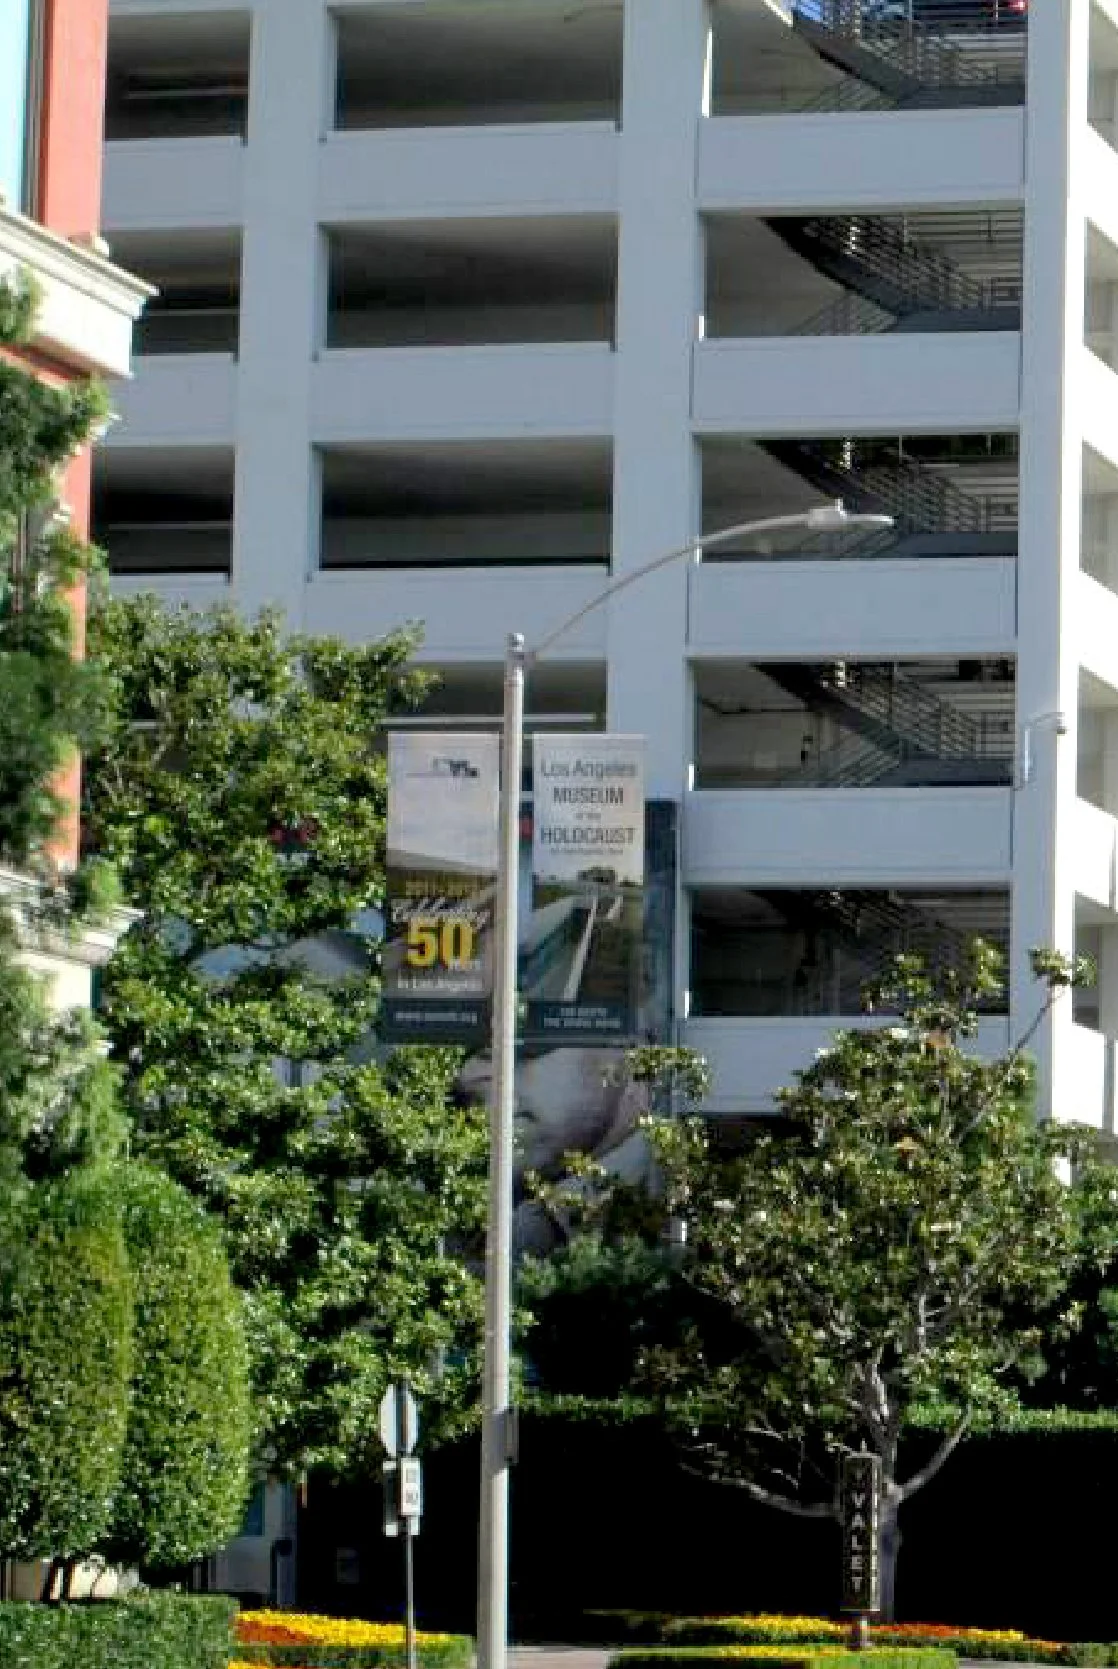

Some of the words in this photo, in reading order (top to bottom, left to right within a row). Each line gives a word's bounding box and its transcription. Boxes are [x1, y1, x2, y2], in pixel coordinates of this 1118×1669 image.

[540, 759, 570, 777] Los
[553, 787, 623, 804] MUSEUM
[540, 827, 635, 844] HOLOCAUST
[407, 916, 473, 969] 50
[851, 1492, 867, 1593] VALET
